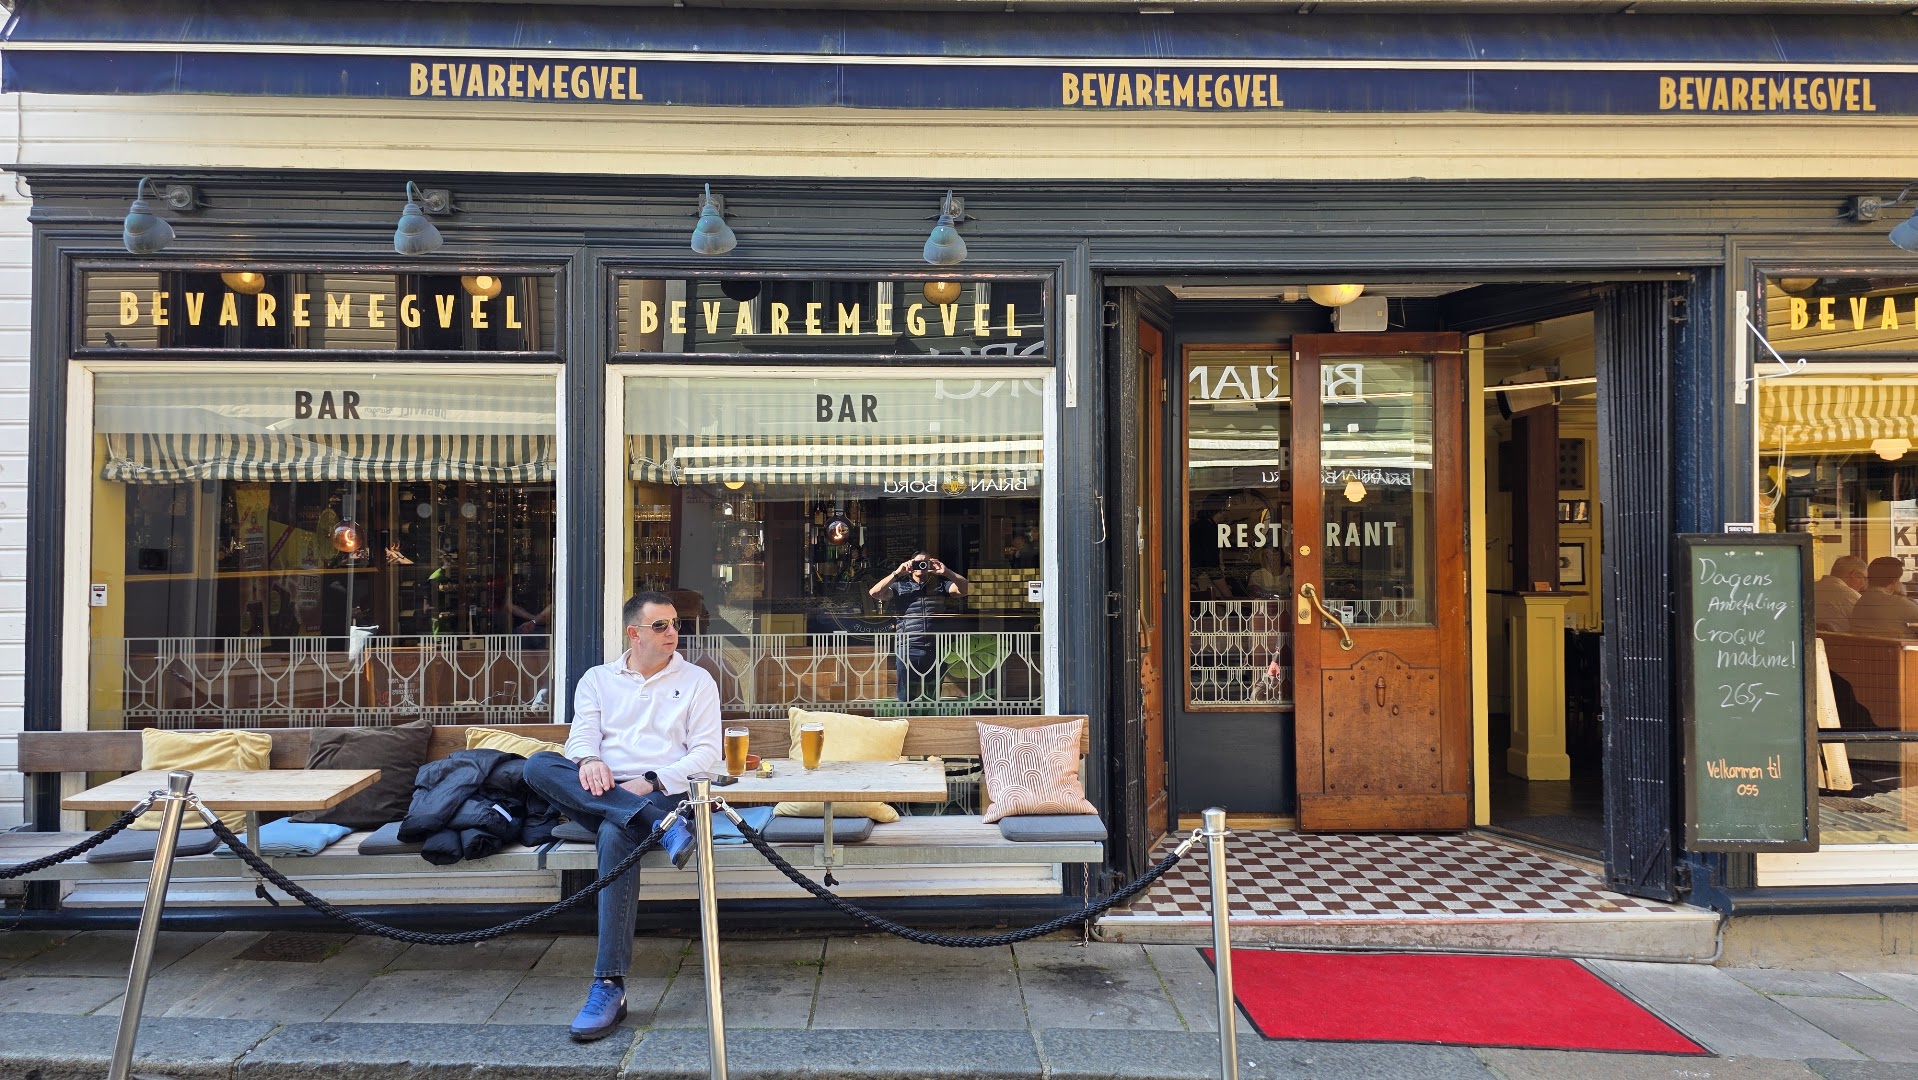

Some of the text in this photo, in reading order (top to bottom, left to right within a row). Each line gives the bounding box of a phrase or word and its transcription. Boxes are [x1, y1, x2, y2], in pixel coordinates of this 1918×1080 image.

[409, 62, 644, 101] BEVAREMEGVEL
[1062, 72, 1285, 109] BEVAREMEGVEL
[1658, 76, 1877, 112] BEVAREMEGVEL
[119, 290, 523, 330] BEVAREMEGVEL
[640, 299, 1022, 337] BEVAREMEGVEL
[1789, 296, 1918, 330] BEVA
[294, 390, 361, 420] BAR
[816, 394, 878, 423] BAR
[1217, 521, 1397, 548] RESTRANT
[1698, 557, 1773, 598] Dagens
[1693, 617, 1766, 645] Croque
[1716, 641, 1797, 669] madame!
[1706, 753, 1782, 781] Velkommen til
[1737, 783, 1760, 797] oss
